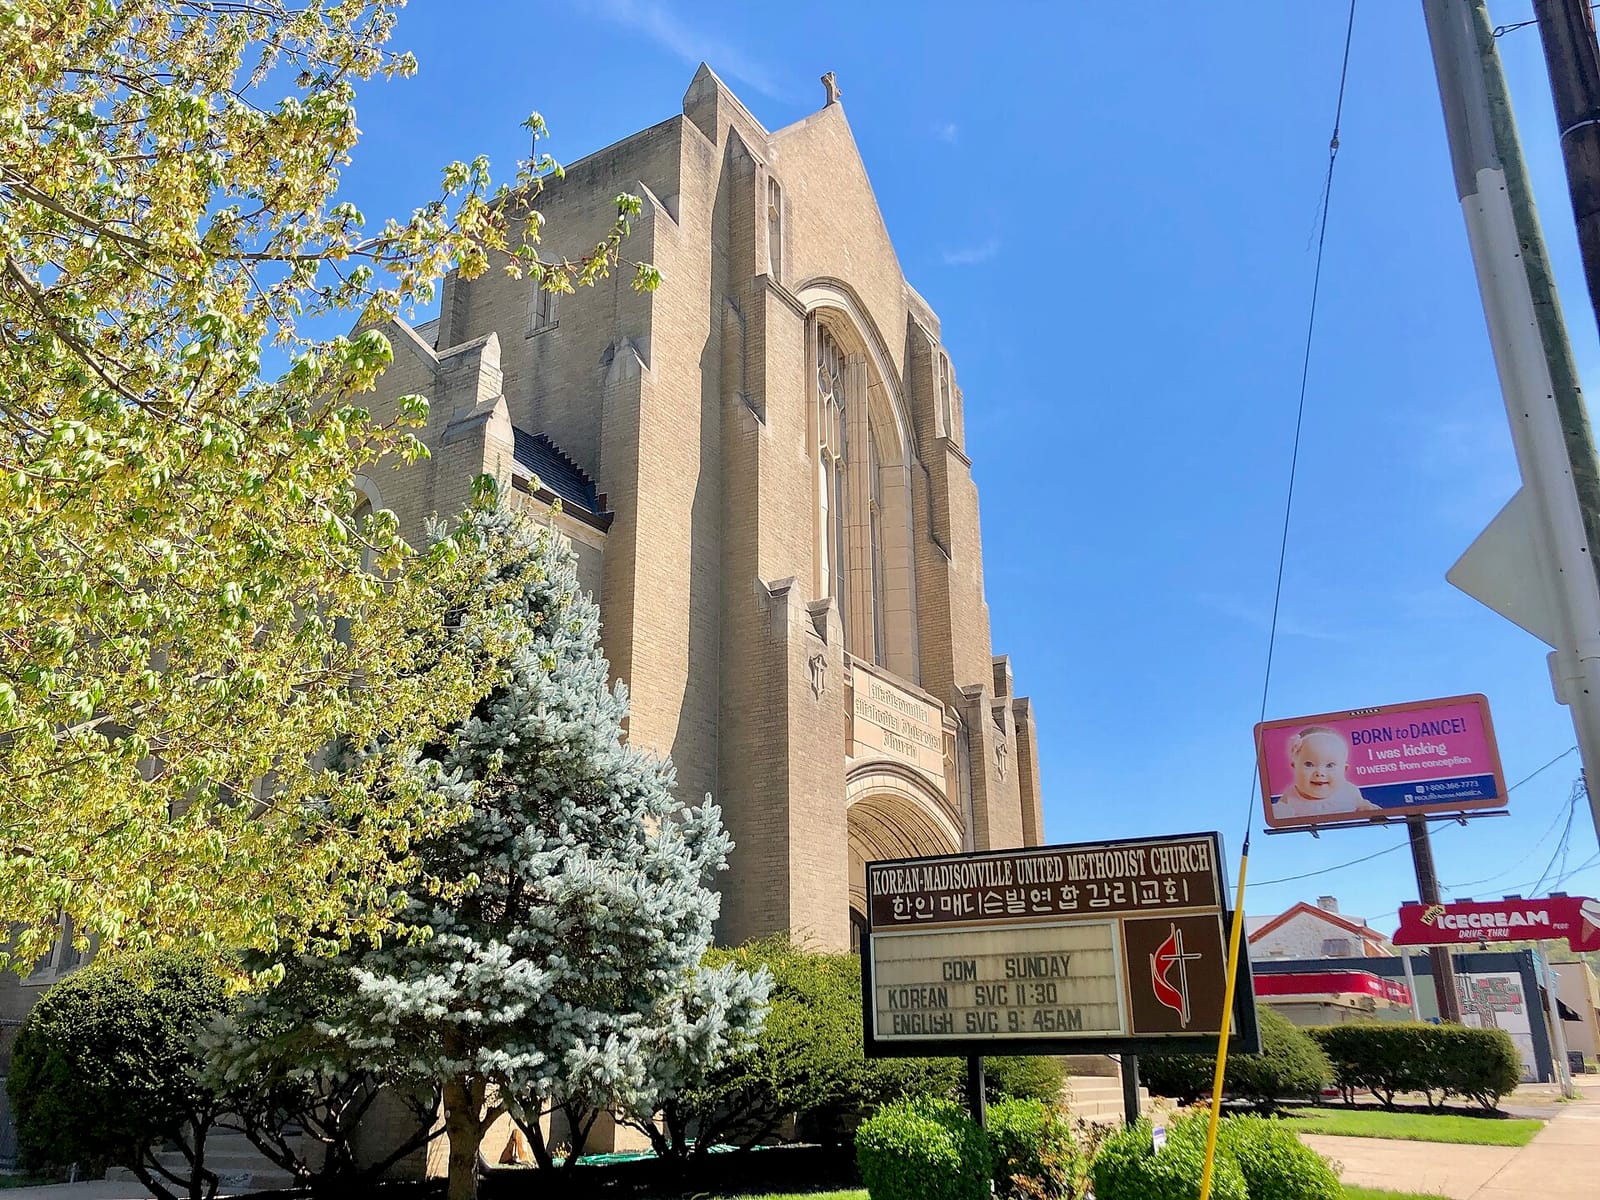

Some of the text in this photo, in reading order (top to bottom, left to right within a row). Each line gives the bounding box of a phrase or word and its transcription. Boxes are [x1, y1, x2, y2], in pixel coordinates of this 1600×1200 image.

[1351, 717, 1467, 746] BORN to DANCE!
[1367, 742, 1448, 761] I was kicking
[1356, 755, 1472, 775] 10 WEEKS from conception
[872, 844, 1210, 896] KOREAN-MADISONVILLE UNITED METHODIST CHURCH
[1423, 906, 1444, 924] KINGS
[1436, 910, 1551, 930] ICECREAM
[1458, 928, 1510, 939] DRIVE THRU
[942, 955, 1071, 981] COM SUNDAY
[888, 987, 948, 1009] KOREAN
[975, 985, 1008, 1006] SVC
[893, 1013, 953, 1034] ENGLISH
[966, 1011, 999, 1034] SVC
